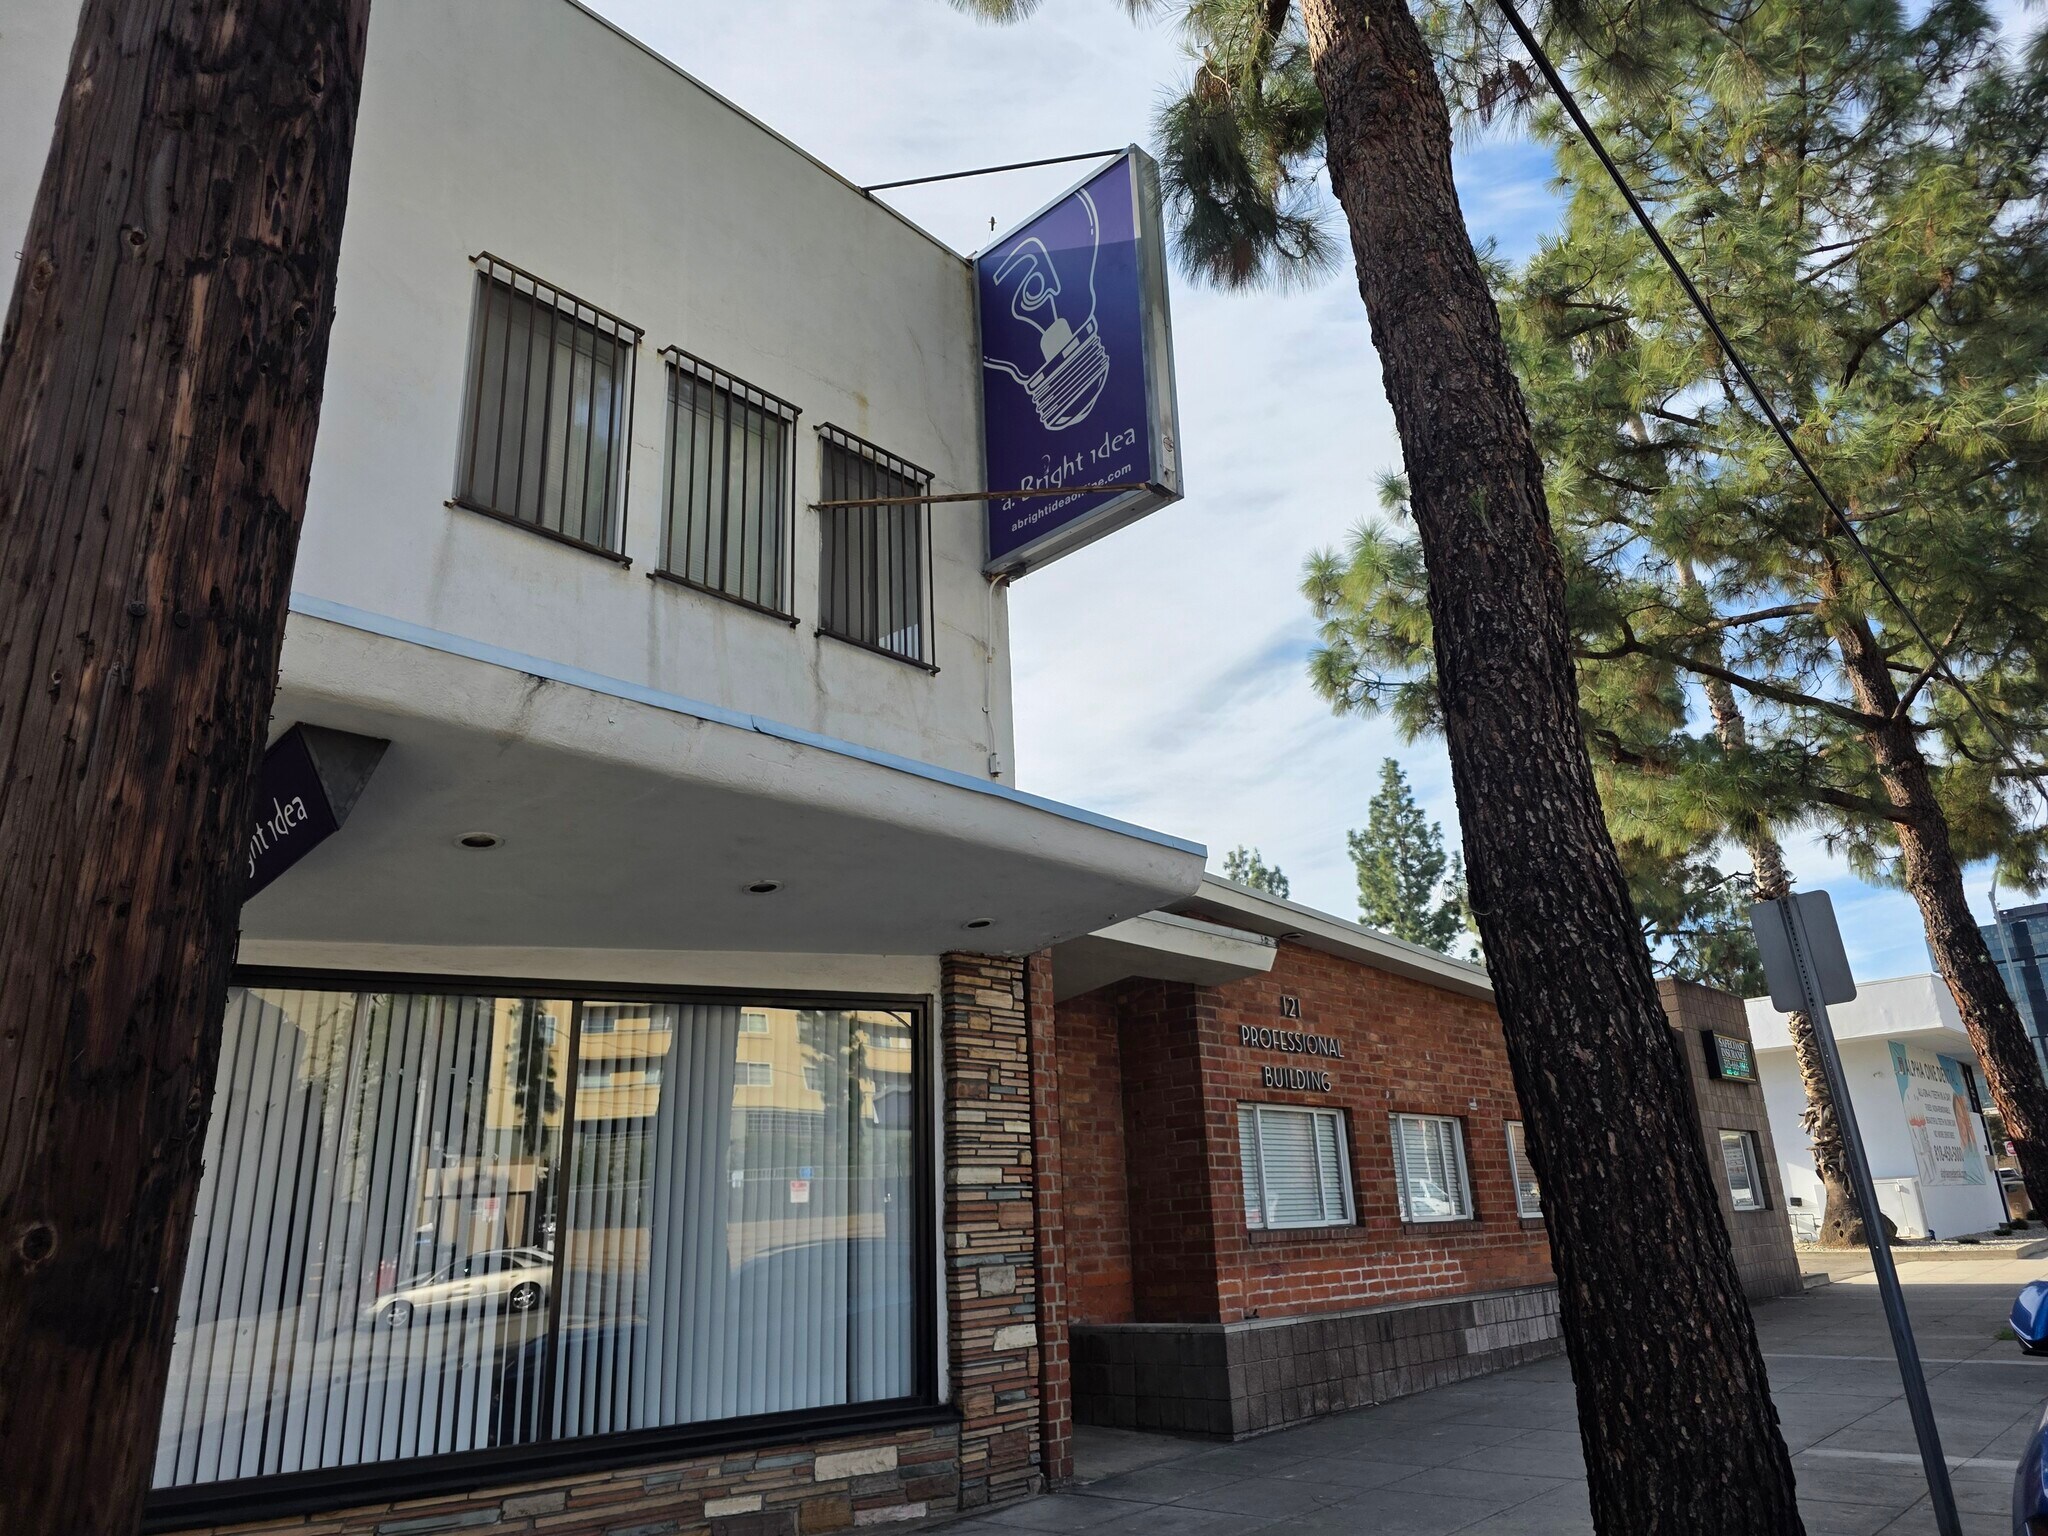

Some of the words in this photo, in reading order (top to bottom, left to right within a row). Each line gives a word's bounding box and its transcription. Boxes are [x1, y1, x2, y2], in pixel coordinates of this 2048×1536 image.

[1021, 454, 1084, 501] Bright
[1090, 428, 1136, 464] idea
[1011, 464, 1132, 532] abrightideaoe.com
[267, 796, 309, 842] idea
[1282, 995, 1302, 1019] 121
[1241, 1025, 1345, 1058] PROFESSIONAL
[1720, 1048, 1747, 1061] INSURANCE
[1264, 1066, 1332, 1092] BUILDING
[1904, 1058, 1926, 1079] ALPHA
[1924, 1062, 1938, 1081] ONE
